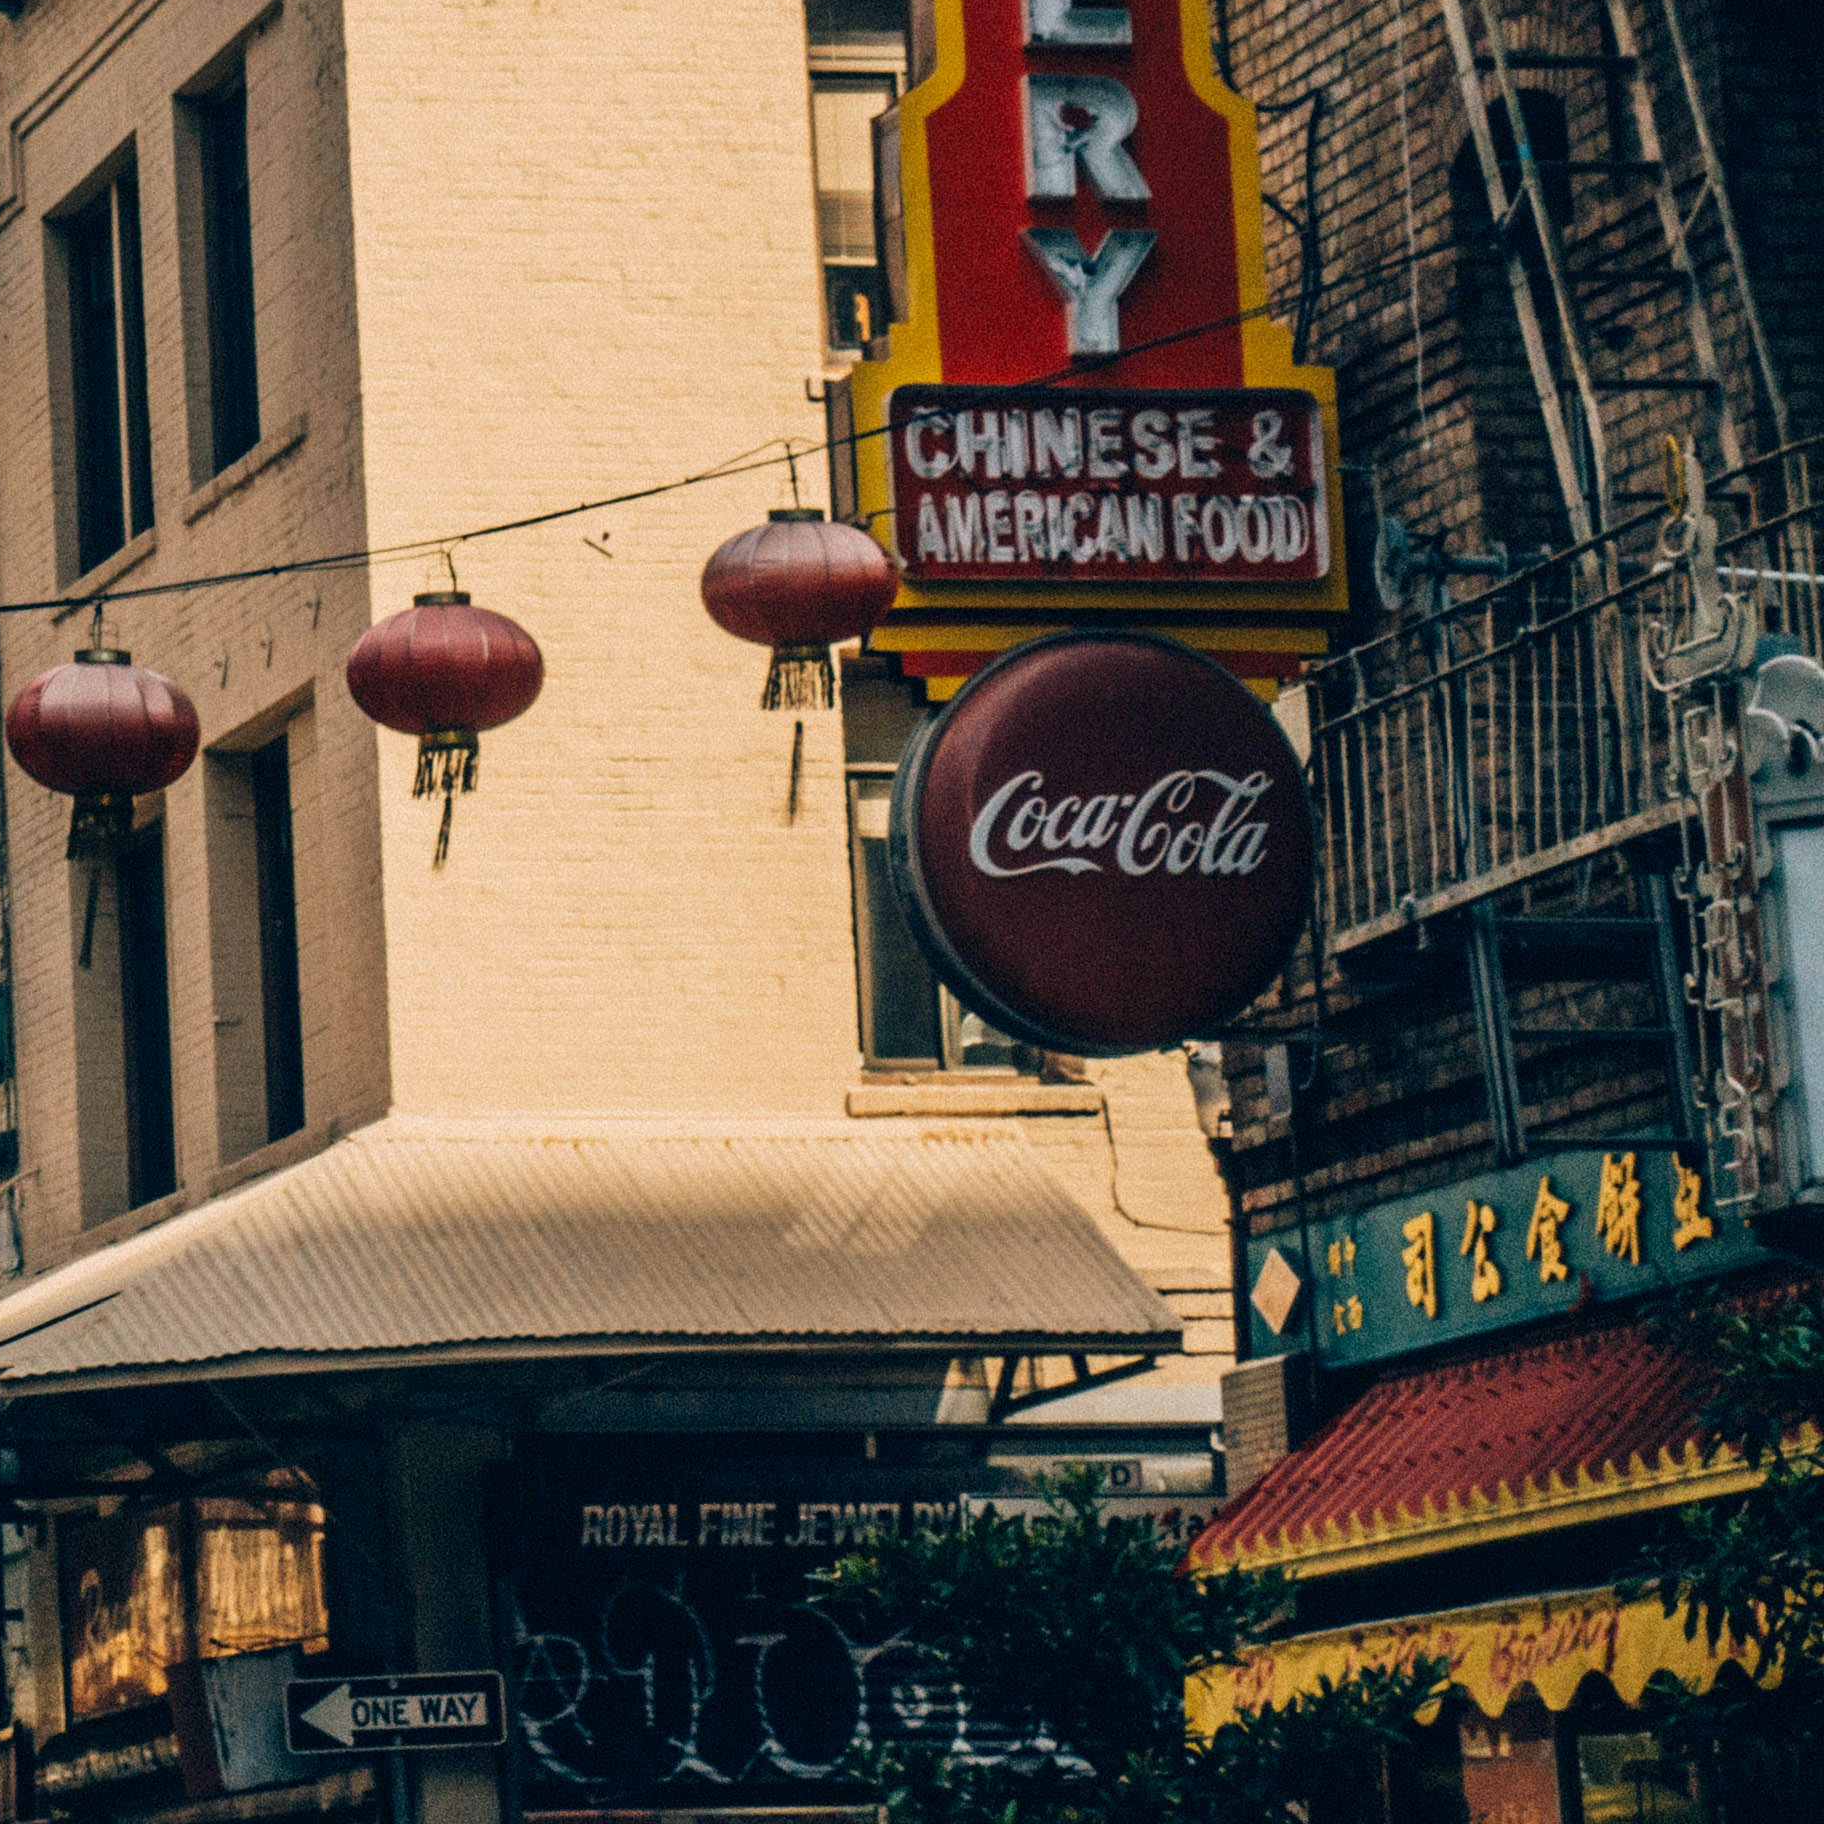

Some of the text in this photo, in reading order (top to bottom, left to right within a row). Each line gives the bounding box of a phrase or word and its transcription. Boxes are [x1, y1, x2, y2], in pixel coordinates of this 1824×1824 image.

[904, 405, 1297, 480] CHINESE &
[916, 492, 1310, 566] AMERICAN FOOD
[968, 769, 1275, 878] Coca-Cola
[582, 1503, 689, 1547] ROYAL
[698, 1503, 776, 1547] FINE
[352, 1695, 478, 1727] ONE WAY
